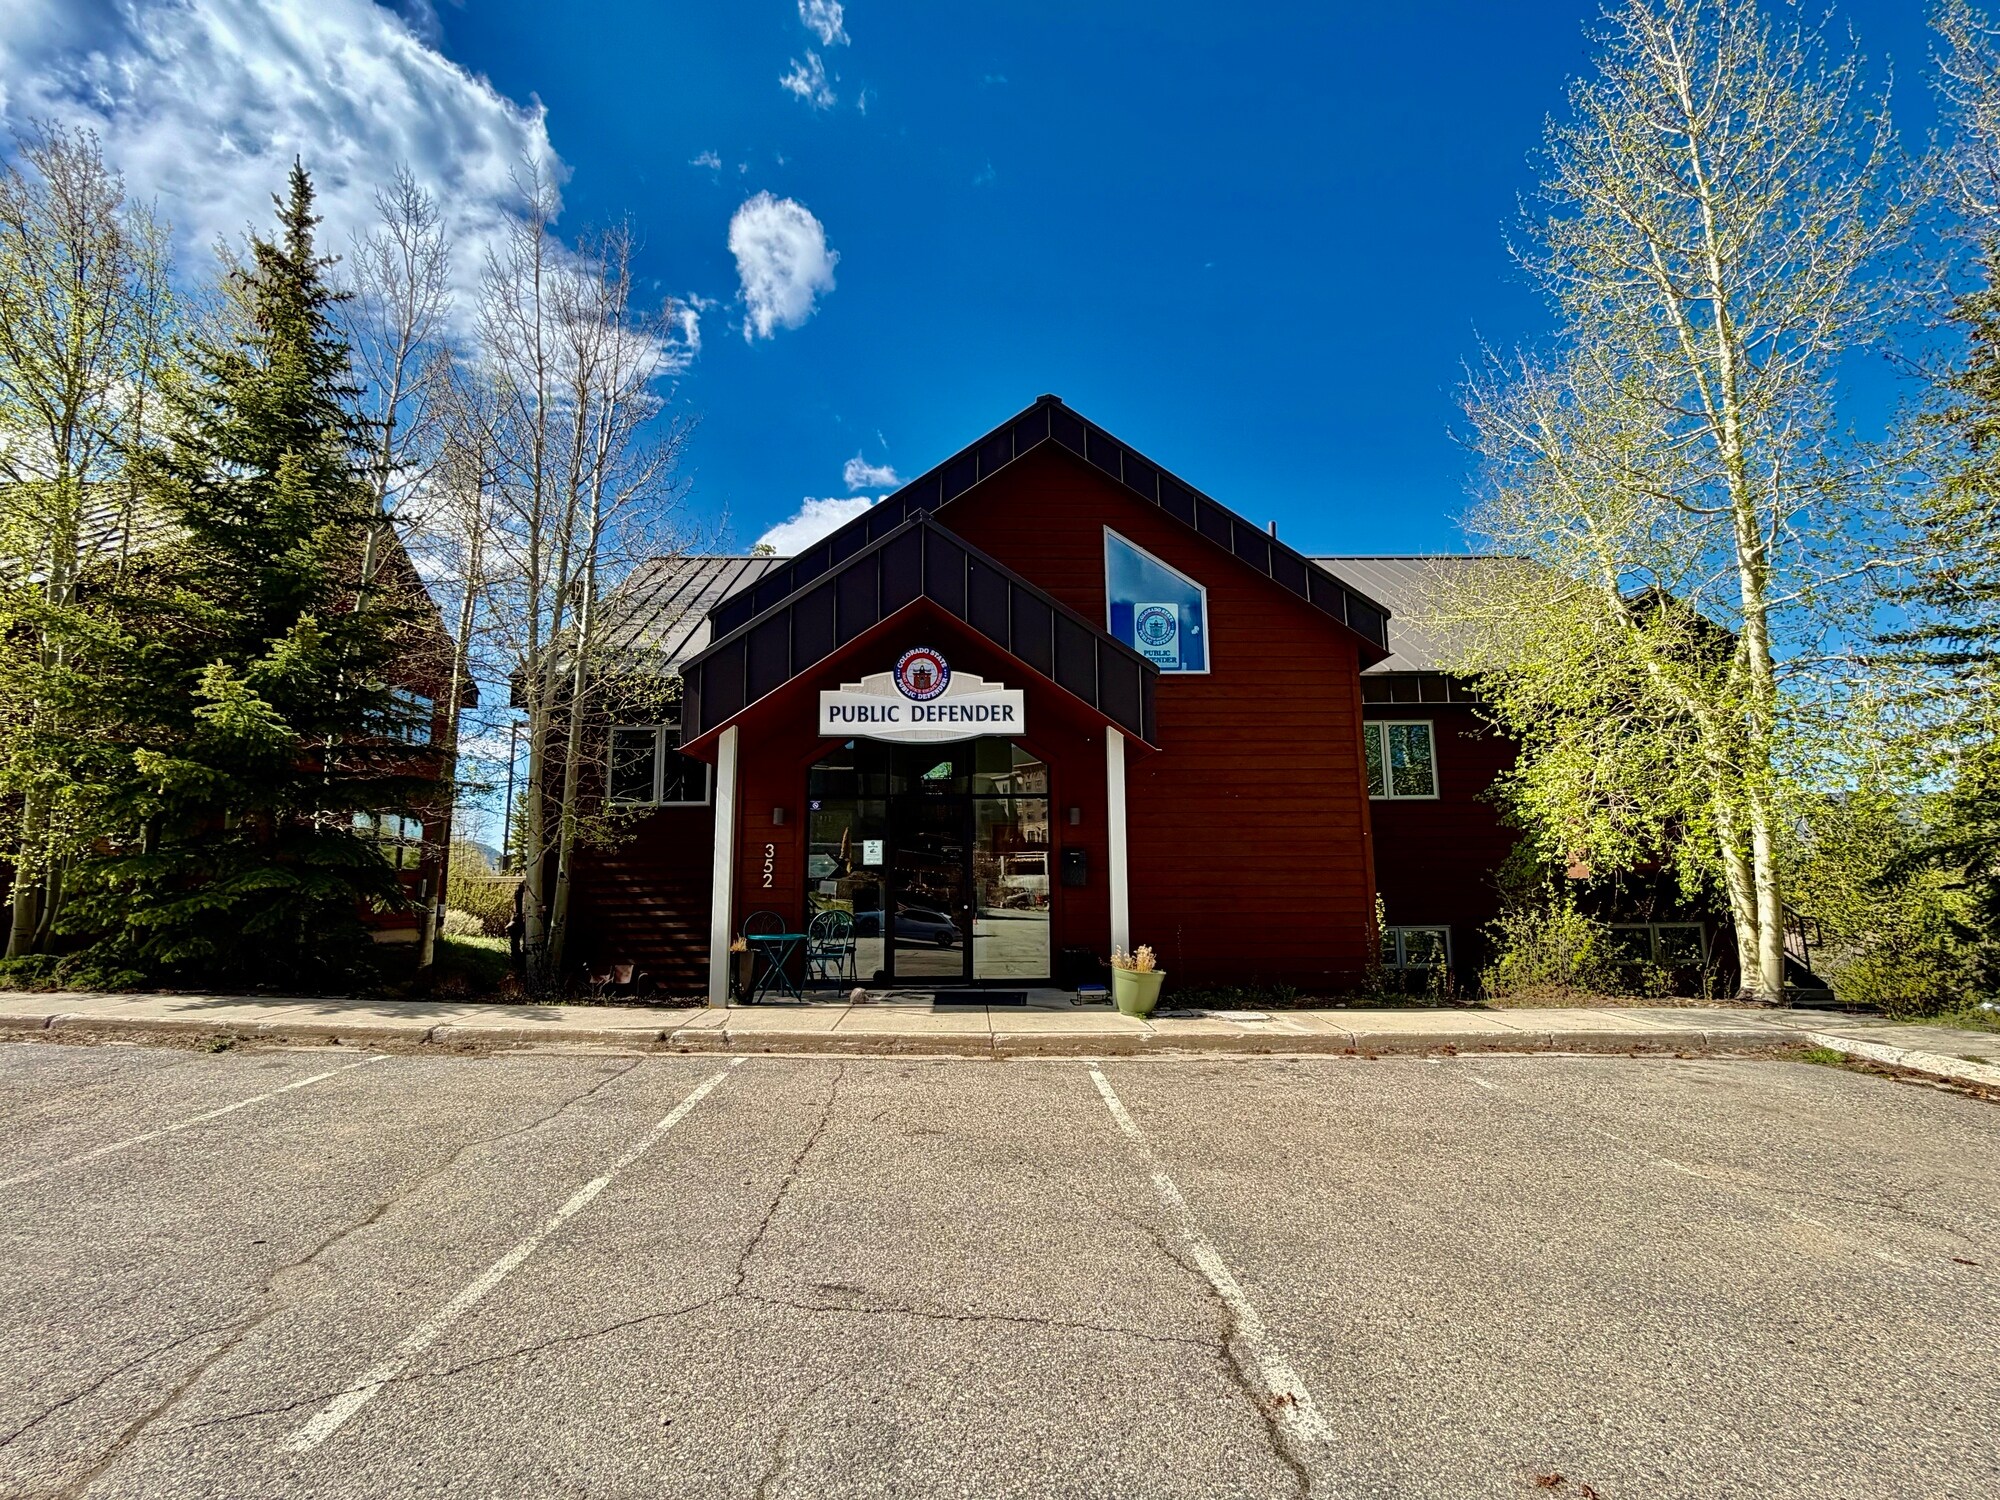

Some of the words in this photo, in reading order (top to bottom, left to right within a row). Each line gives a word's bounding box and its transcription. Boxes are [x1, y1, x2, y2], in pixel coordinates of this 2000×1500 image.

[897, 647, 930, 669] COLORADO
[930, 649, 948, 669] STATE
[897, 678, 917, 698] PUBLIC
[917, 677, 948, 700] DEFENDER
[829, 705, 900, 723] PUBLIC
[911, 704, 1015, 722] DEFENDER
[762, 843, 775, 888] 352
